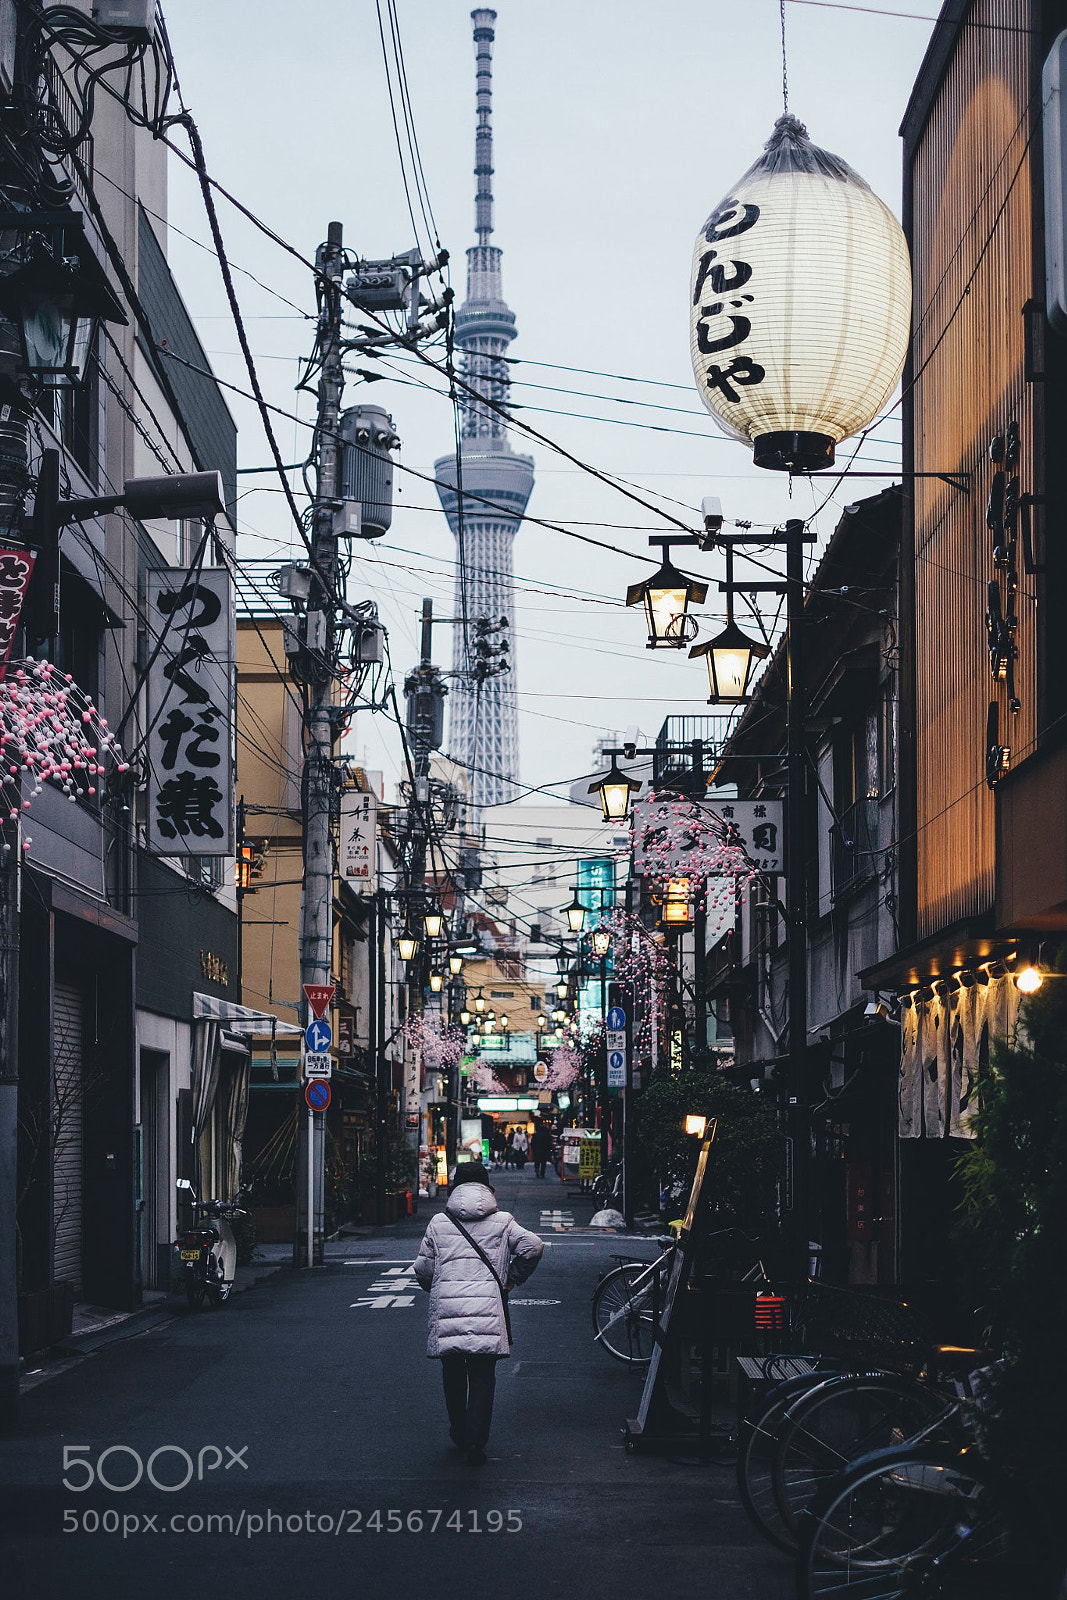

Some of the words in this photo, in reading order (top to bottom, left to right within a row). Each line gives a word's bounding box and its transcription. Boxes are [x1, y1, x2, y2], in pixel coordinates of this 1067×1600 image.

[155, 581, 224, 839] つくだ煮
[310, 992, 330, 1000] 止まれ
